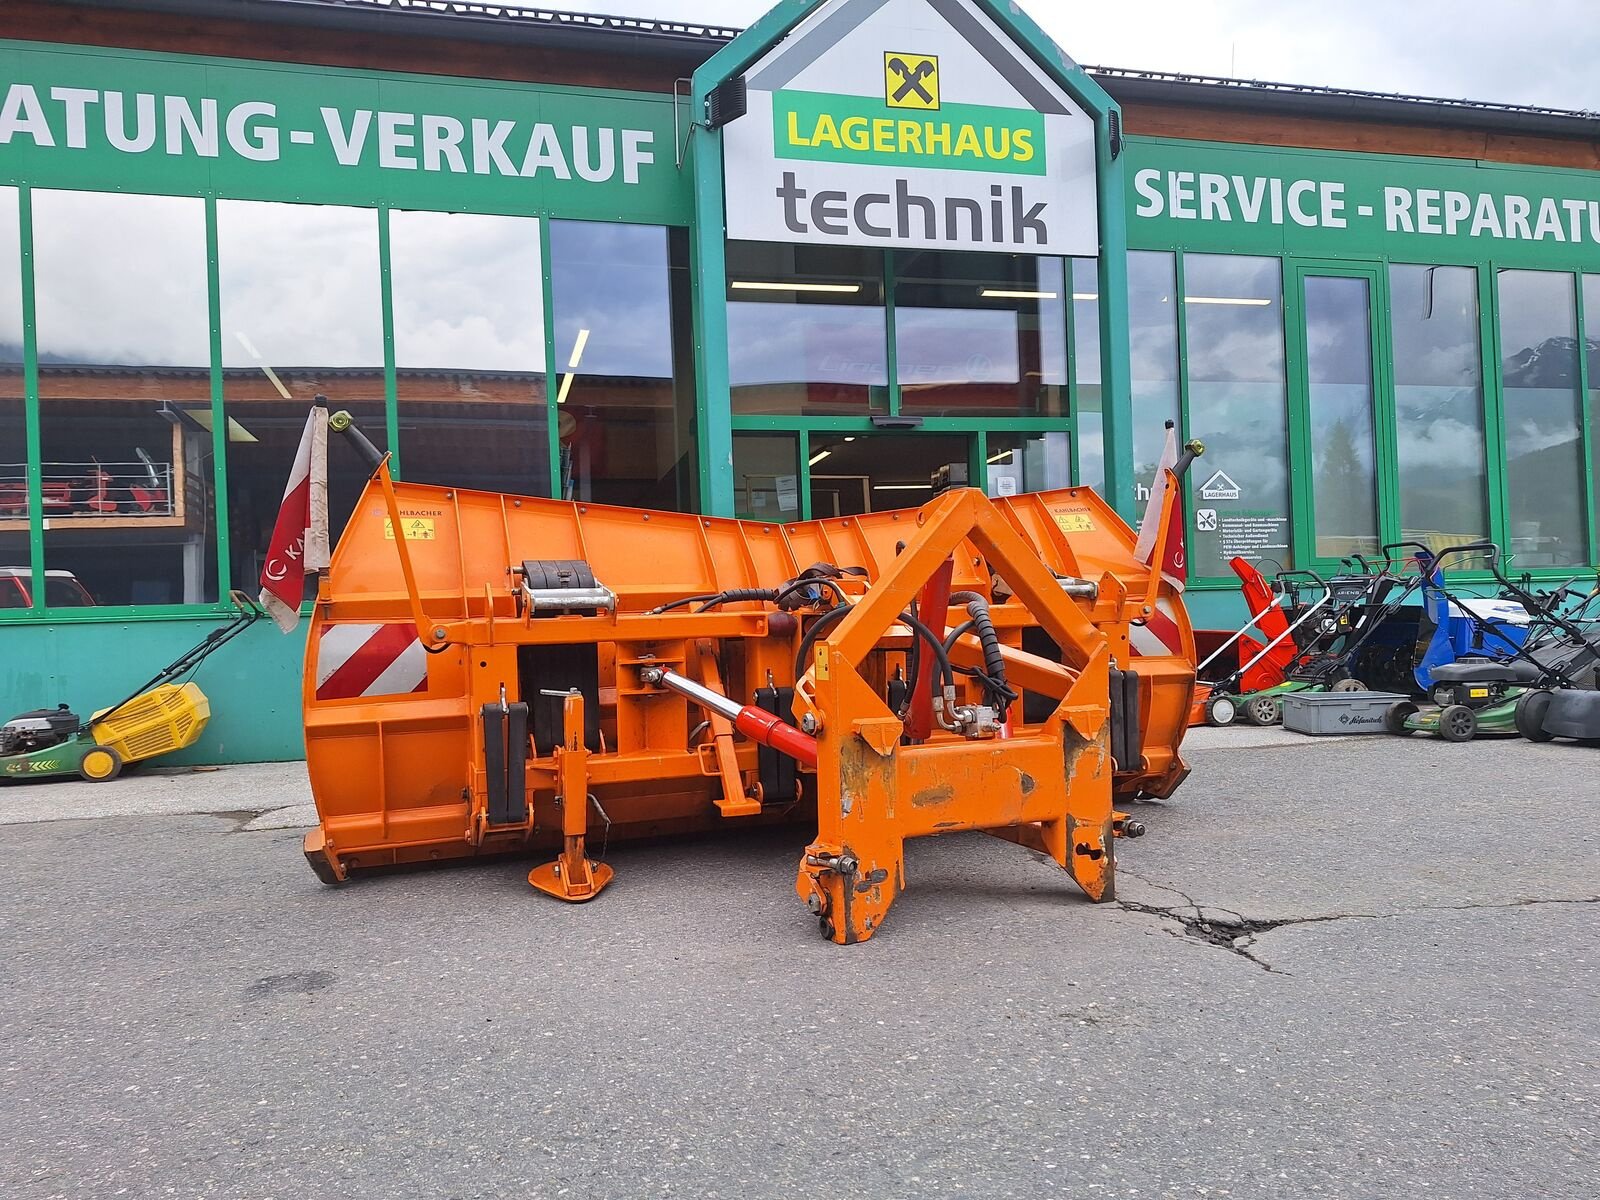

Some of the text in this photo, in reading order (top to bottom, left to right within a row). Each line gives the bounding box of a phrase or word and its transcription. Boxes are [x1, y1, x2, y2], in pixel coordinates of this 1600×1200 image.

[787, 111, 1034, 161] LAGERHAUS
[776, 172, 1047, 244] technik
[1135, 168, 1347, 228] SERVICE
